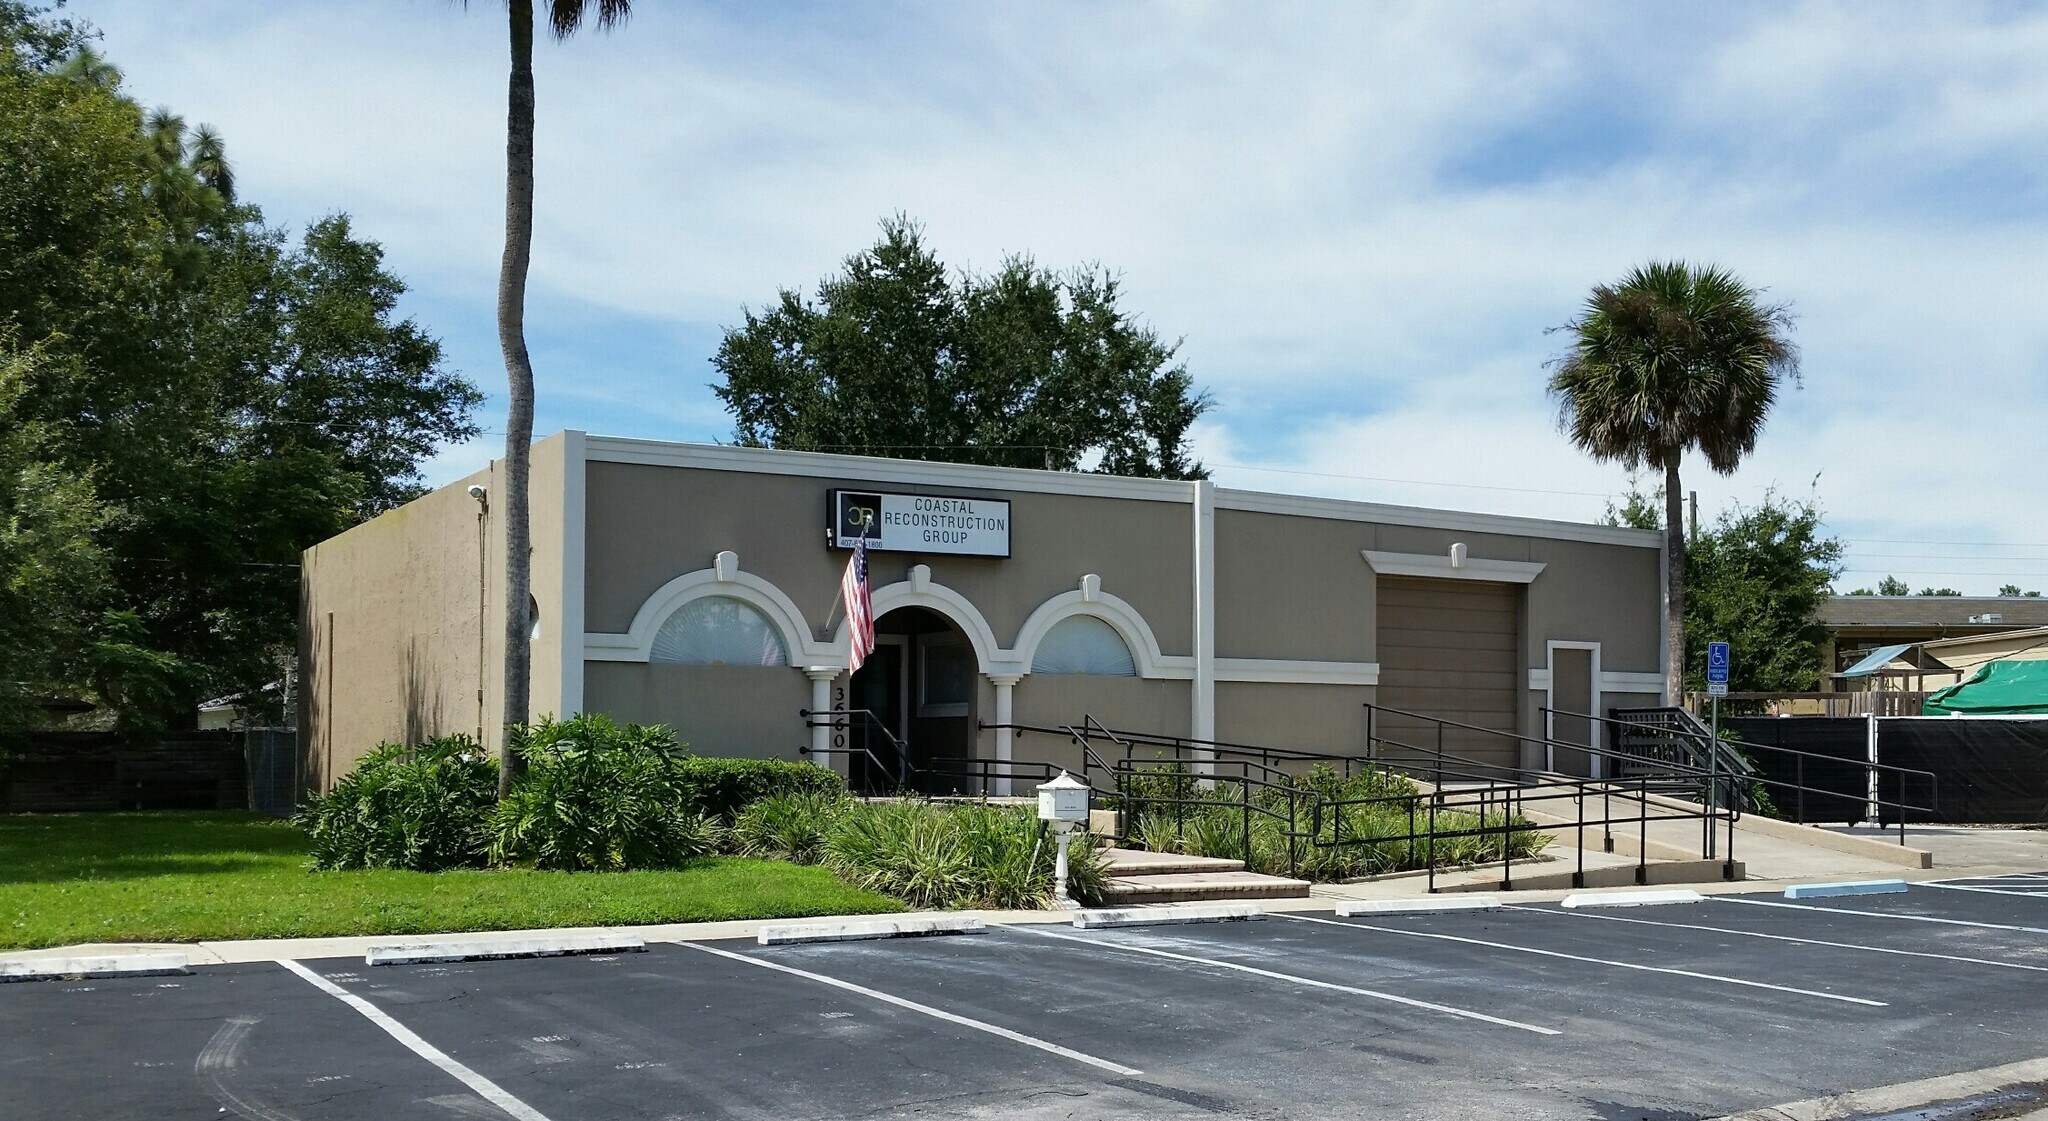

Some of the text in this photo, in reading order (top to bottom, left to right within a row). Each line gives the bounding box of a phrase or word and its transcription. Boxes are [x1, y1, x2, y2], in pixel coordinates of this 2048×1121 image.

[915, 498, 975, 514] COASTAL
[885, 512, 1005, 531] RECONSTRUCTION
[923, 530, 968, 544] GROUP
